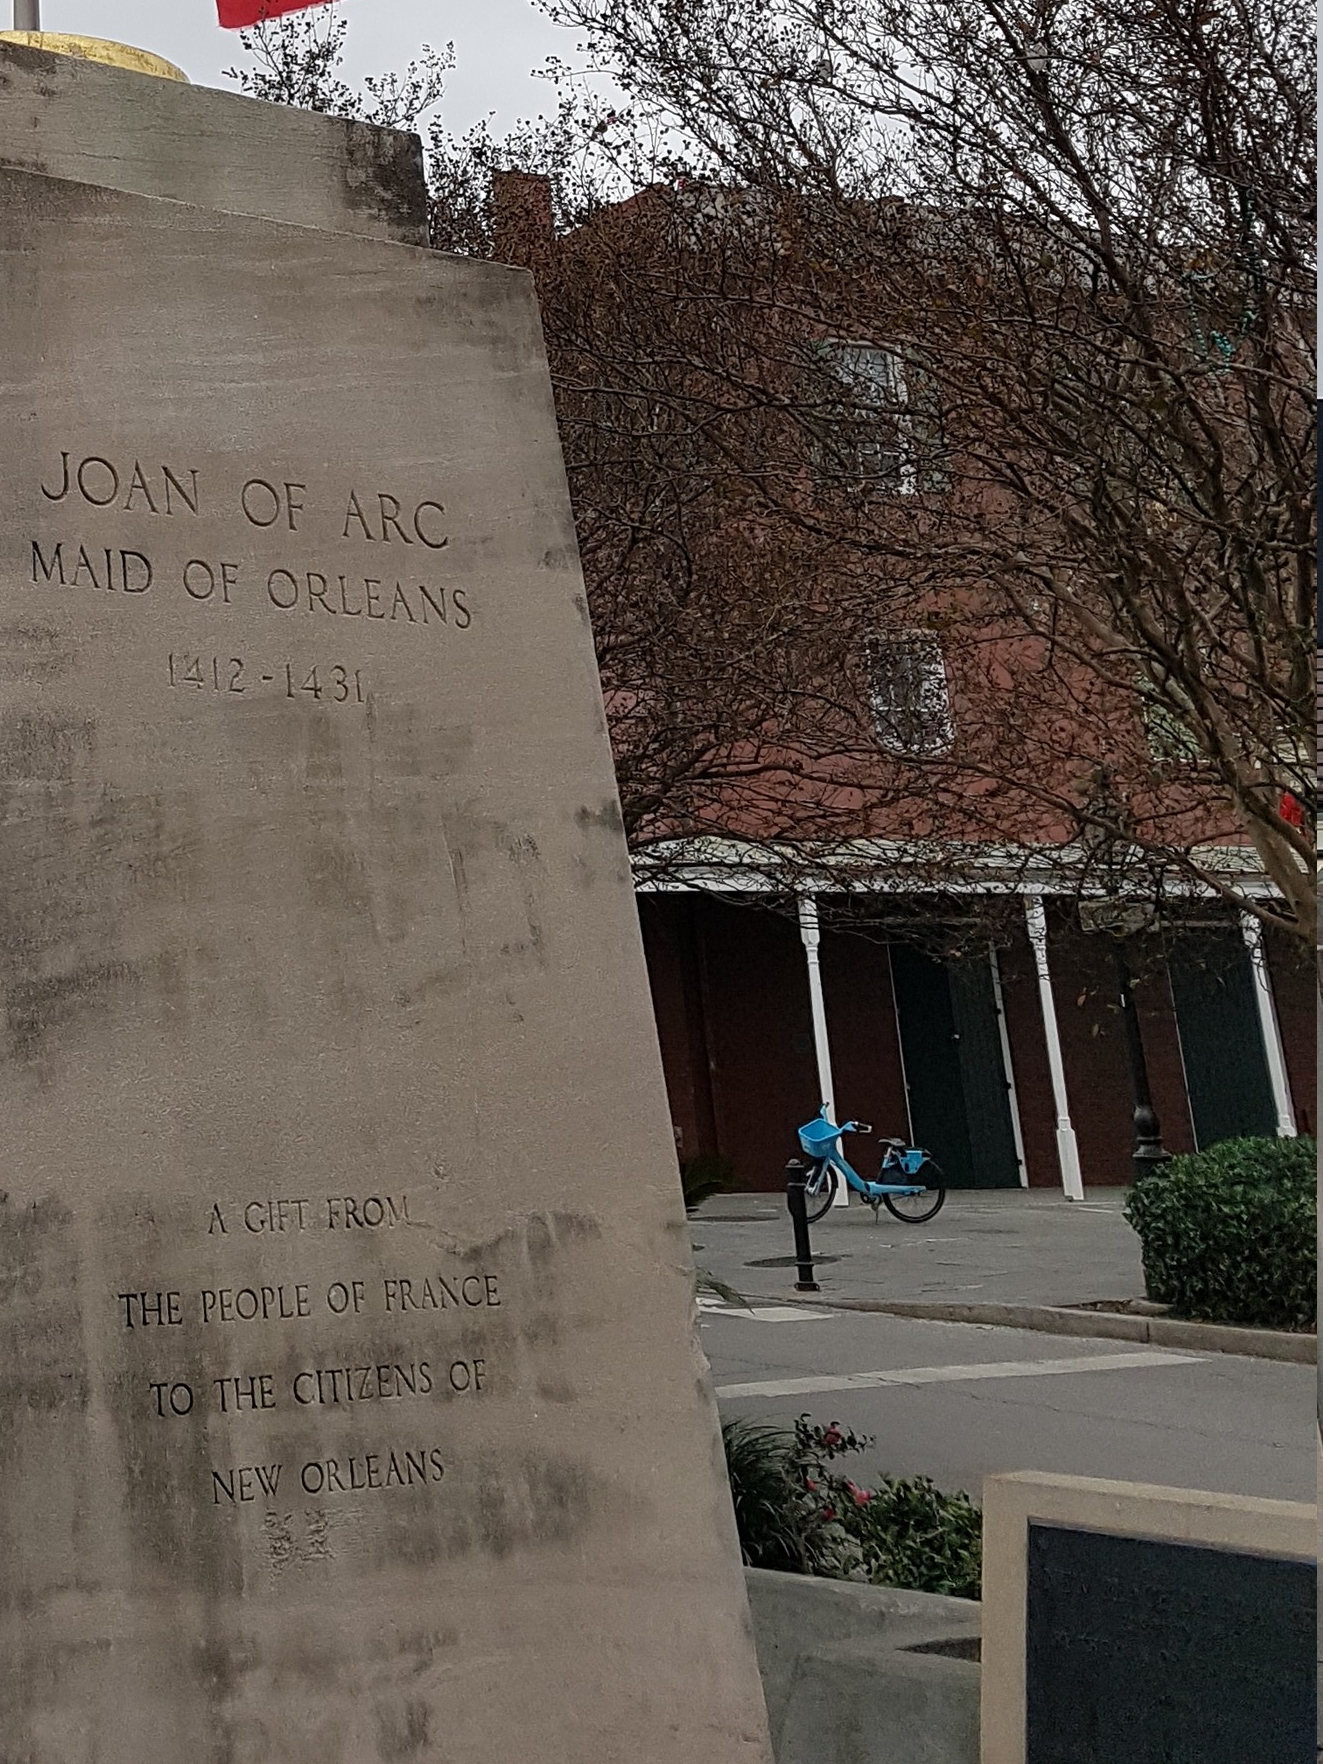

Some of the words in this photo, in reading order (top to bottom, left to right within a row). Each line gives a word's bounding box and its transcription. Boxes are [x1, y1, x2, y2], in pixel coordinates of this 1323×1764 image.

[41, 451, 200, 516] JOAN
[241, 478, 306, 532] OF
[341, 488, 450, 550] ARC
[30, 540, 153, 593] MAID
[183, 558, 239, 605] OF
[267, 568, 472, 630] ORLEANS
[168, 652, 365, 703] 1412-1431
[207, 1202, 228, 1235] A
[244, 1198, 309, 1233] GIFT
[327, 1195, 412, 1230] FROM
[118, 1291, 183, 1329] THE
[202, 1284, 312, 1324] PEOPLE
[327, 1281, 366, 1314] OF
[384, 1275, 502, 1312] FRANCE
[149, 1382, 194, 1418] TO
[213, 1374, 276, 1413] THE
[293, 1361, 433, 1405] CITIZENS
[449, 1358, 487, 1392] OF
[211, 1463, 283, 1506] NEW
[301, 1448, 445, 1494] ORLEANS
